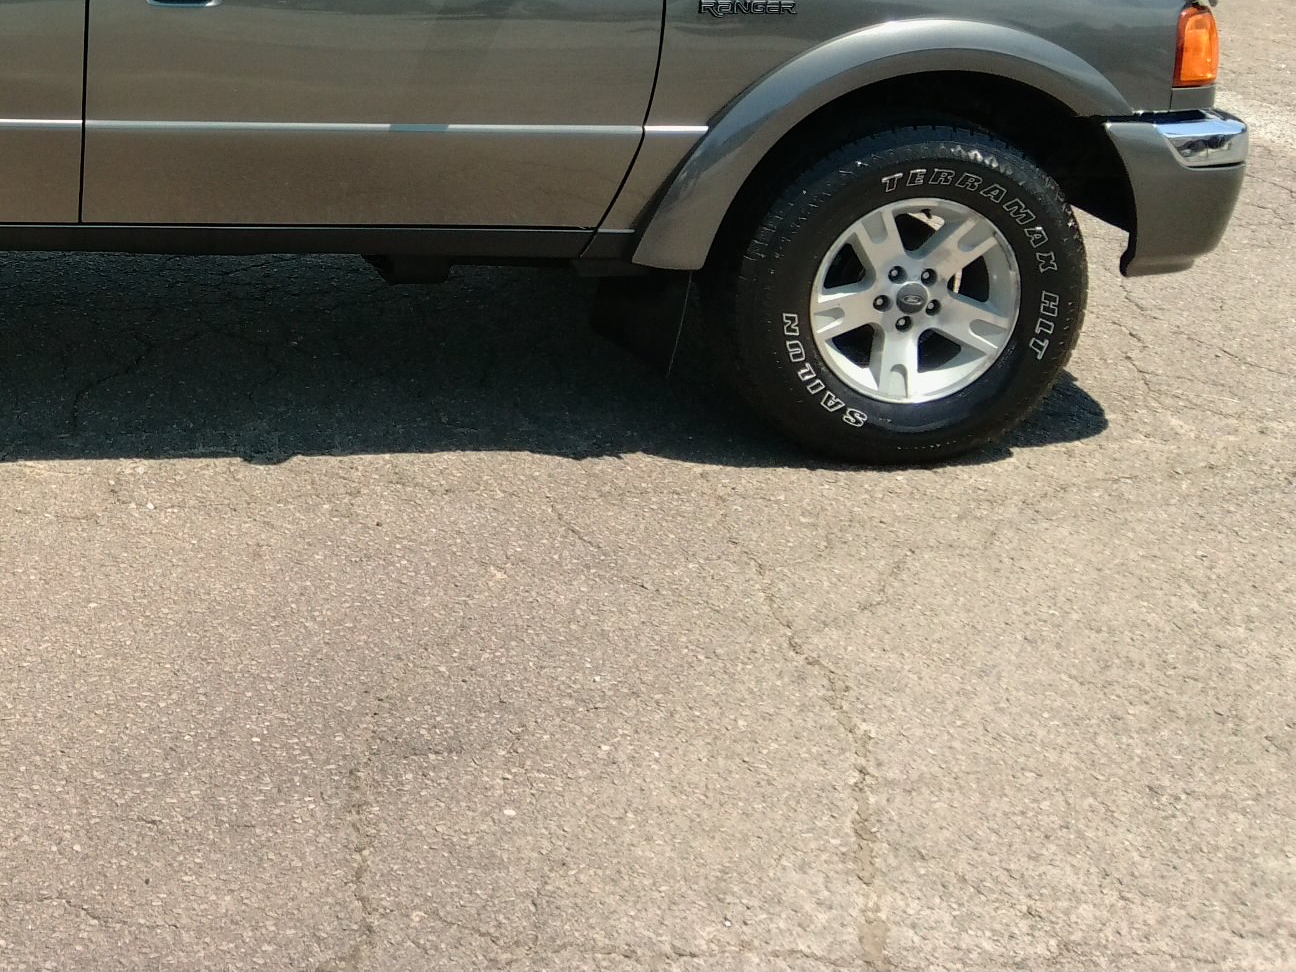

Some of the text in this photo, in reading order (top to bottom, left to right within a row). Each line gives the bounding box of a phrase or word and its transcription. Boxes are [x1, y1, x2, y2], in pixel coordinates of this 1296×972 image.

[881, 168, 1058, 273] TERRAMAX
[782, 312, 868, 427] SAILUN
[1028, 290, 1060, 360] HLT
